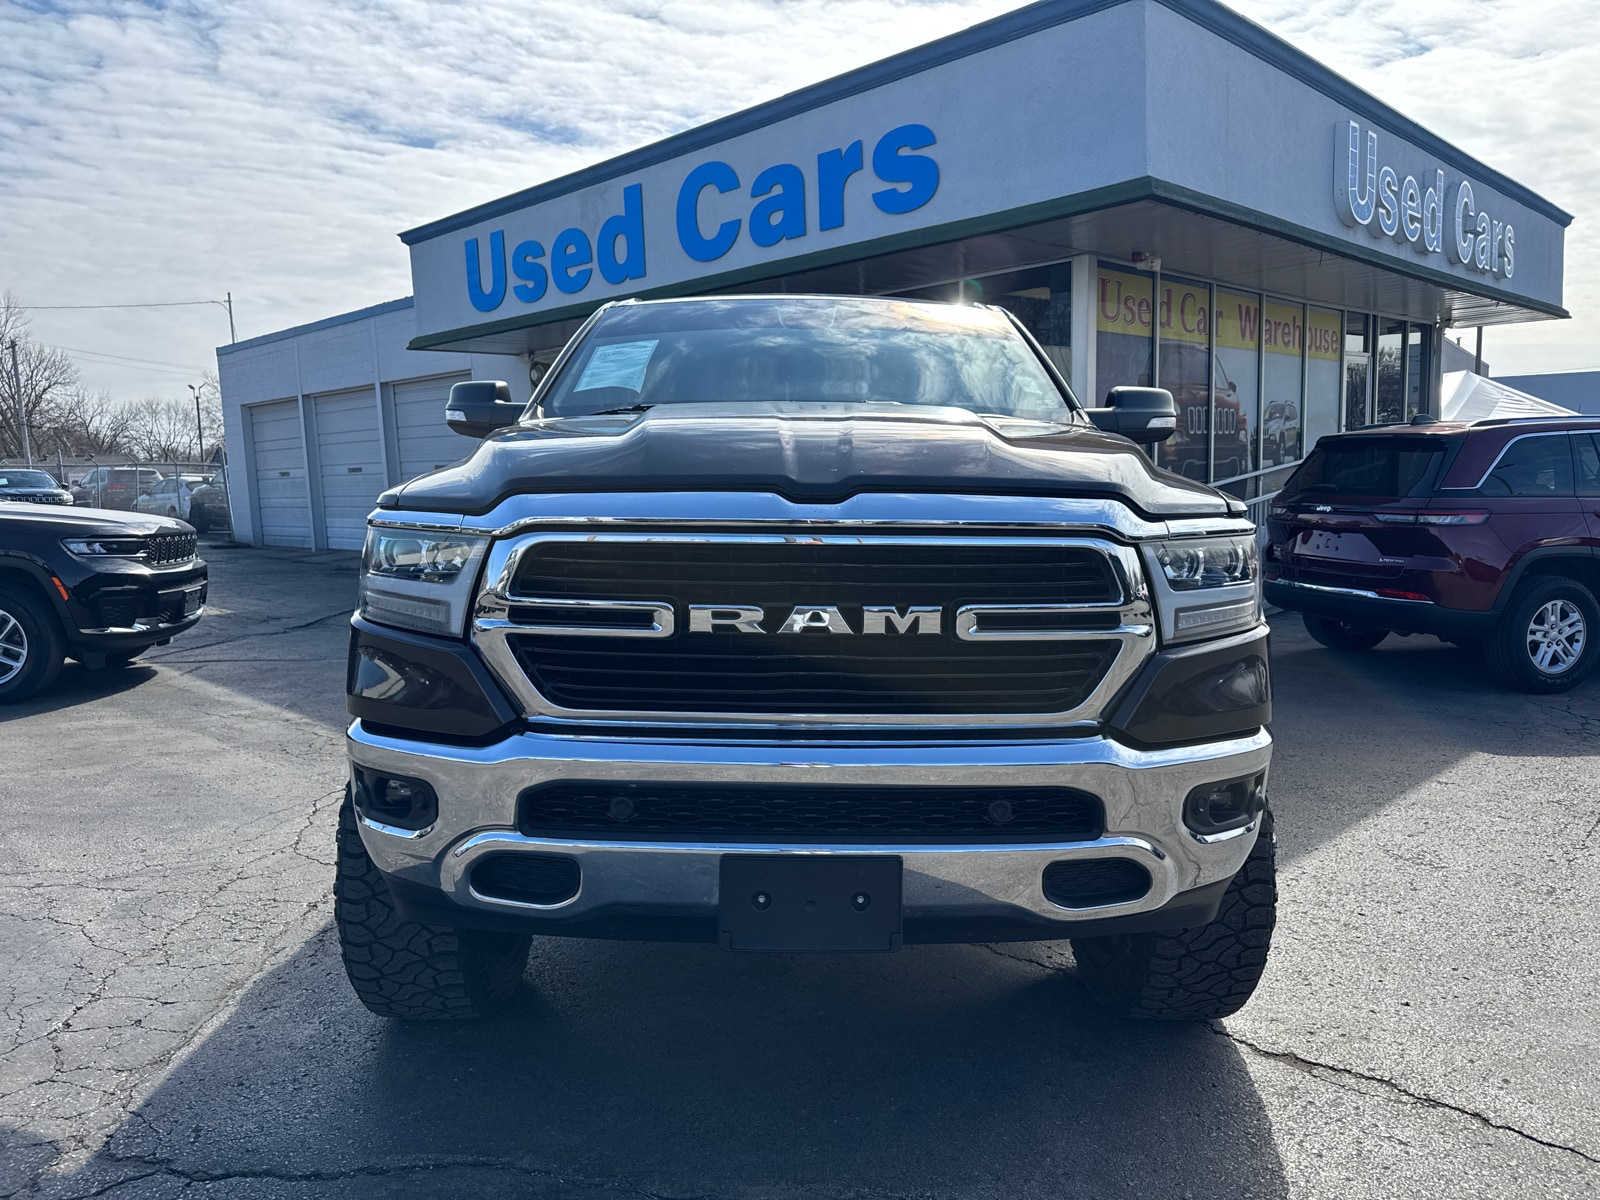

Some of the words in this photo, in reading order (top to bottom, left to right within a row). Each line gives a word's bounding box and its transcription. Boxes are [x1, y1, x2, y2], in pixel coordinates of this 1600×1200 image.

[464, 183, 646, 312] Used
[676, 123, 940, 262] Cars
[1346, 120, 1443, 252] Used
[1453, 180, 1515, 278] Cars
[1099, 277, 1173, 329] Used
[1181, 292, 1223, 337] Car
[1238, 303, 1339, 353] Warehouse
[689, 604, 942, 635] RAM
